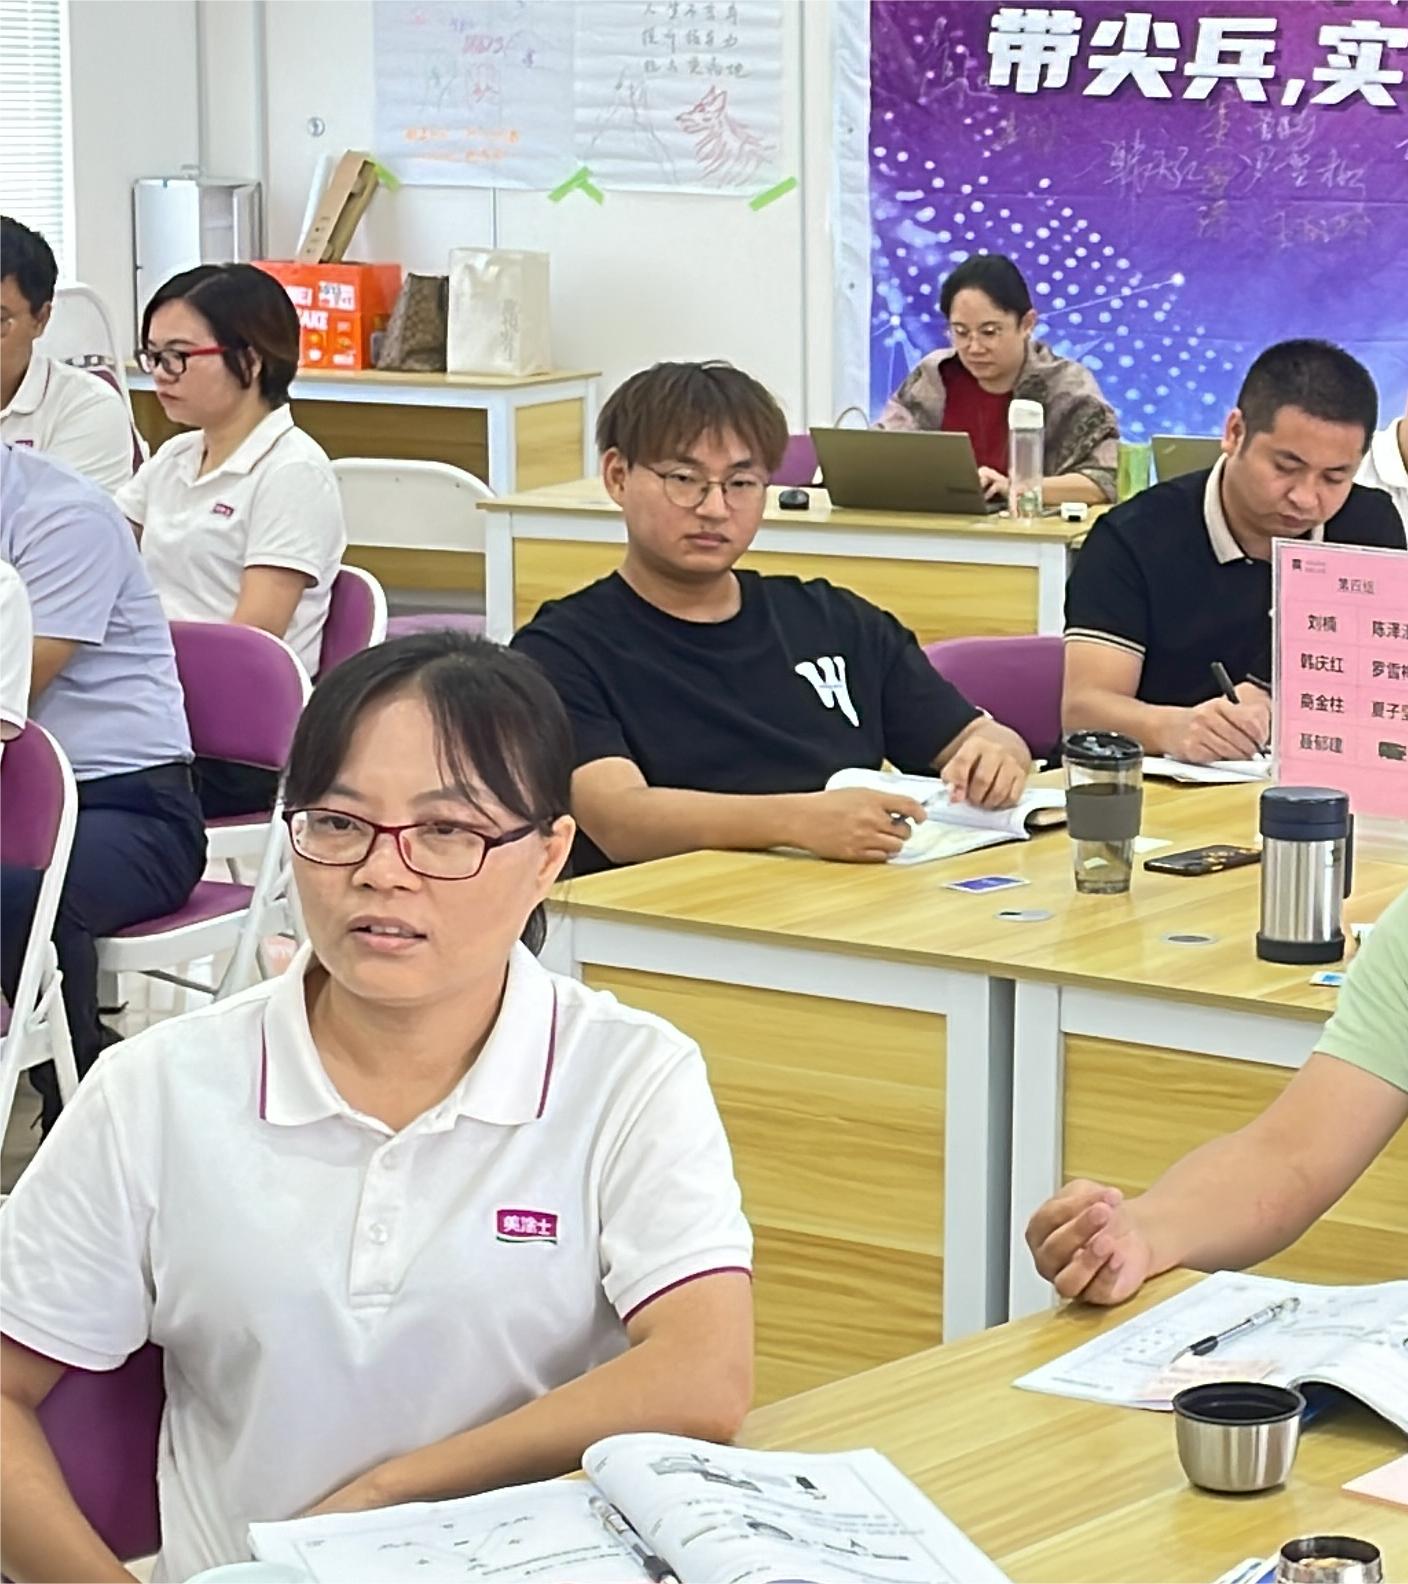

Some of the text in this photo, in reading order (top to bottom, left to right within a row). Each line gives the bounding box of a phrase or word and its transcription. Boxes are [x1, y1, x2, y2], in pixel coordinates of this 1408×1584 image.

[1337, 577, 1375, 595] 第四组
[1300, 652, 1344, 674] 韩庆红
[503, 1215, 552, 1235] 美涂士
